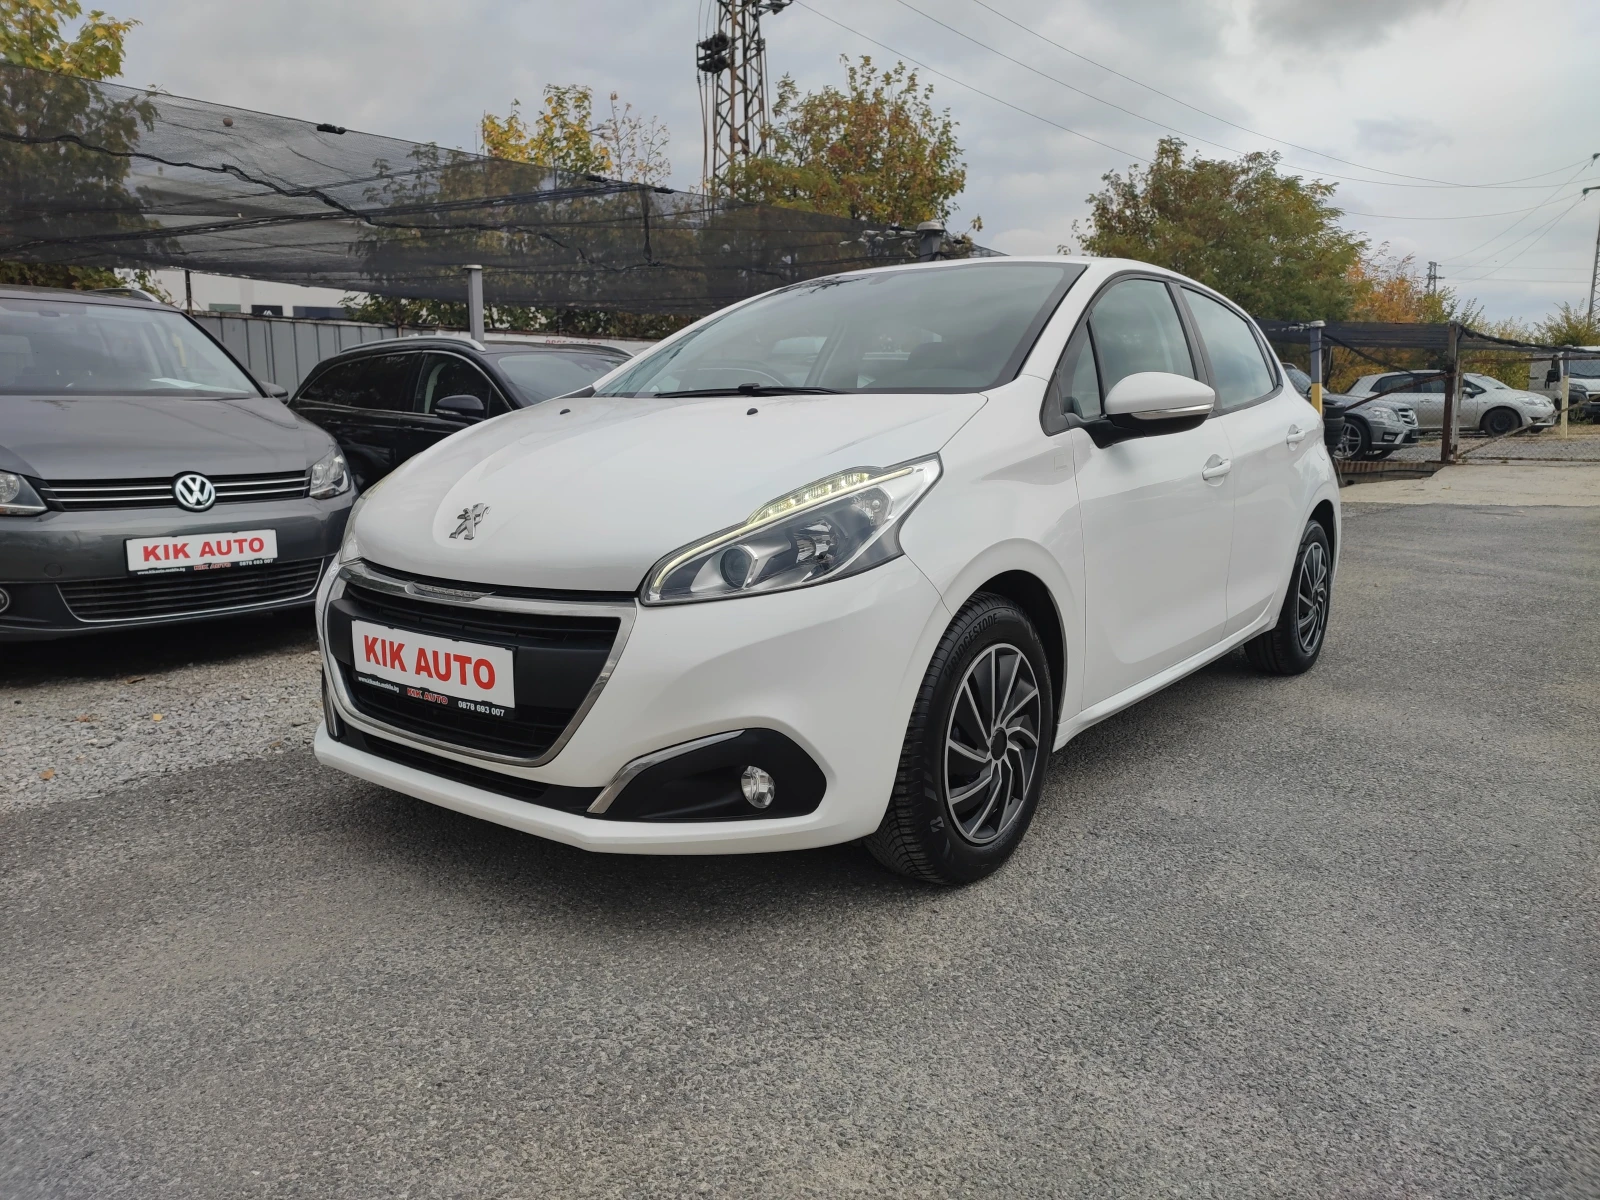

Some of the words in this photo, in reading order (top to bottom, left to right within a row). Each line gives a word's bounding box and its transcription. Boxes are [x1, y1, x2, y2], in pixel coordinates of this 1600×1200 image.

[143, 543, 190, 562] KIK
[199, 538, 264, 557] AUTO
[364, 635, 407, 672] KIK
[415, 648, 496, 690] AUTO
[407, 687, 422, 699] KIK
[424, 692, 449, 704] AUTO
[458, 701, 474, 710] 0878
[476, 704, 490, 713] 693
[491, 708, 505, 716] 007
